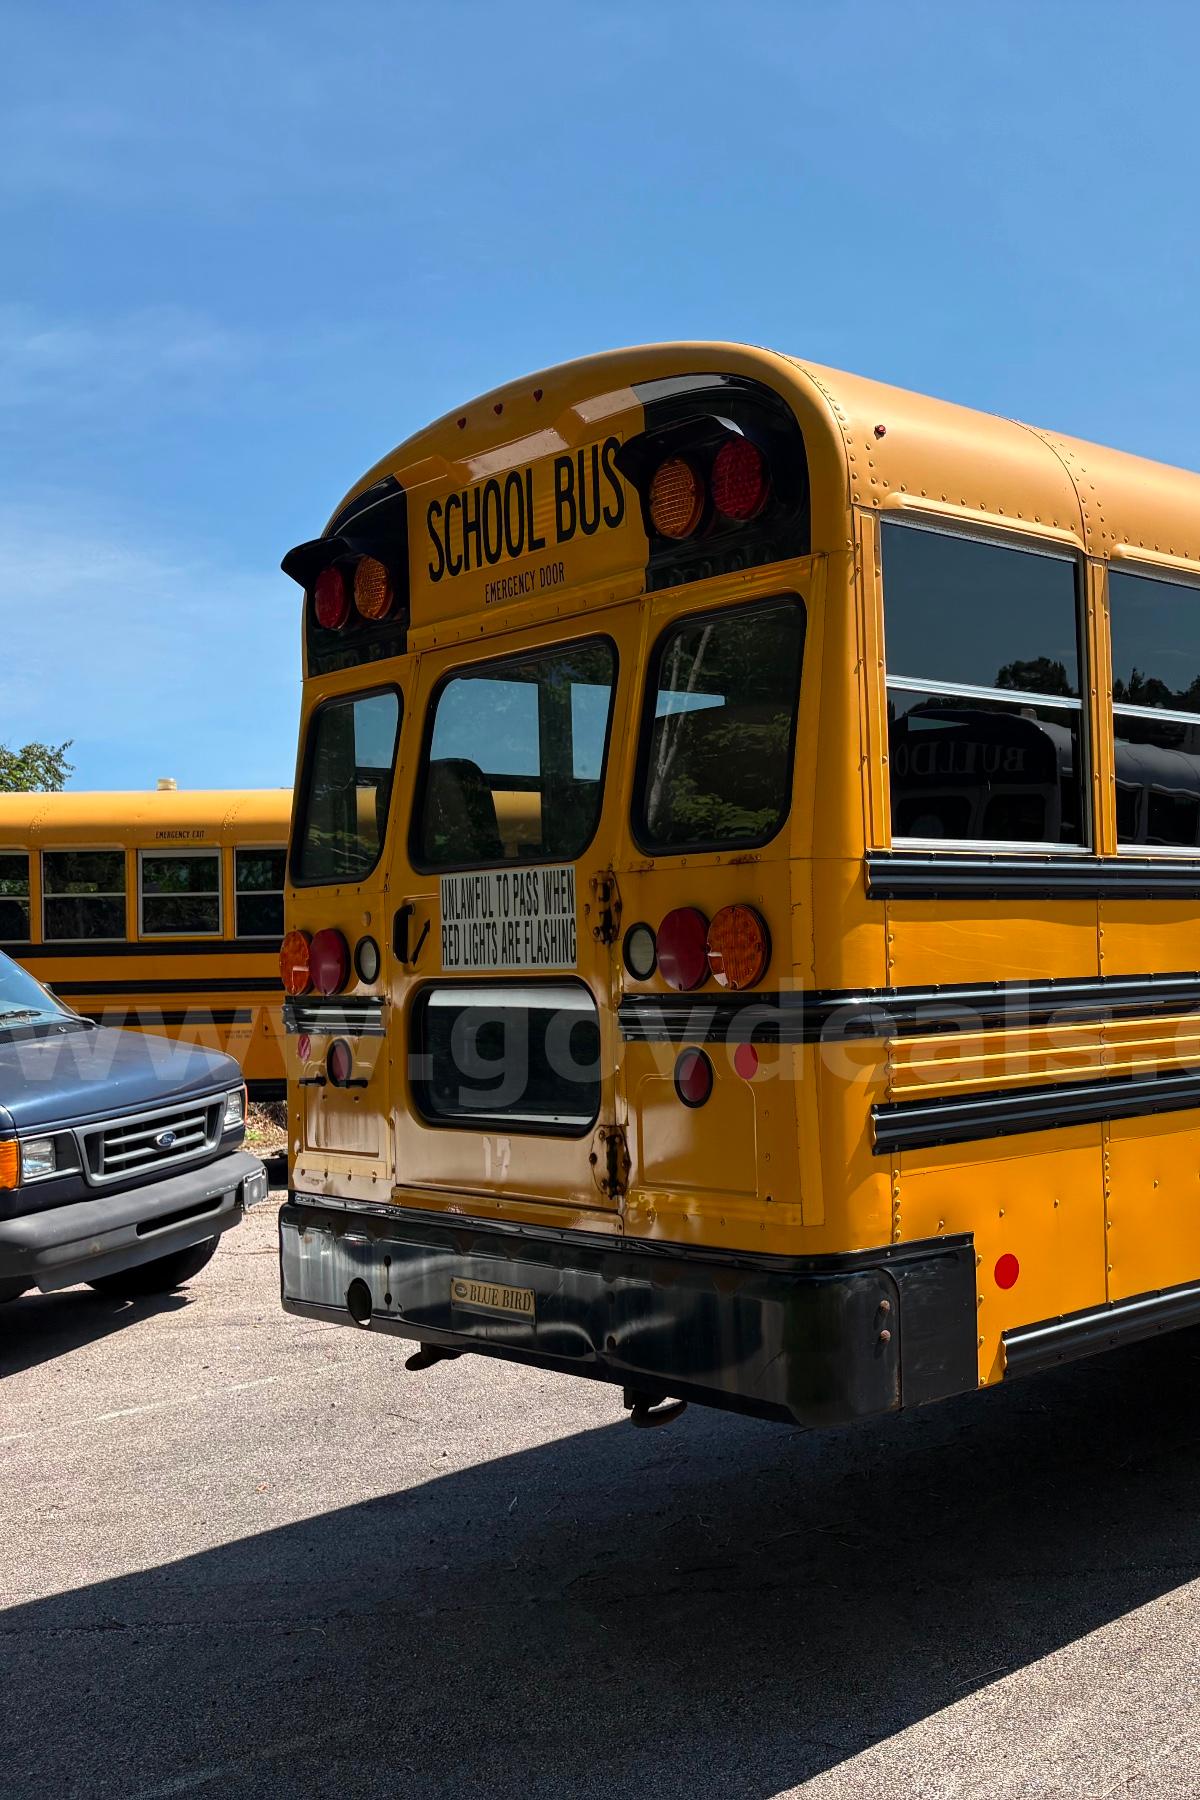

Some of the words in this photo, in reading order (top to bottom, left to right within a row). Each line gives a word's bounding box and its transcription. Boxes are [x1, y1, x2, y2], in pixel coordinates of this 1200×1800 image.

[427, 468, 546, 583] SCHOOL
[555, 436, 625, 544] BUS
[485, 571, 535, 604] EMERGENCY
[539, 562, 565, 586] DOOR
[155, 831, 190, 839] EMERGENCY
[441, 875, 494, 922] UNLAWFUL
[496, 874, 512, 918] TO
[514, 870, 539, 917] PASS
[542, 868, 575, 915] WHEN
[441, 923, 460, 966] RED
[463, 921, 498, 966] LIGHTS
[501, 920, 521, 965] ARE
[524, 917, 577, 965] FLASHING
[470, 1284, 499, 1305] BLUE
[502, 1289, 531, 1311] BIRD
